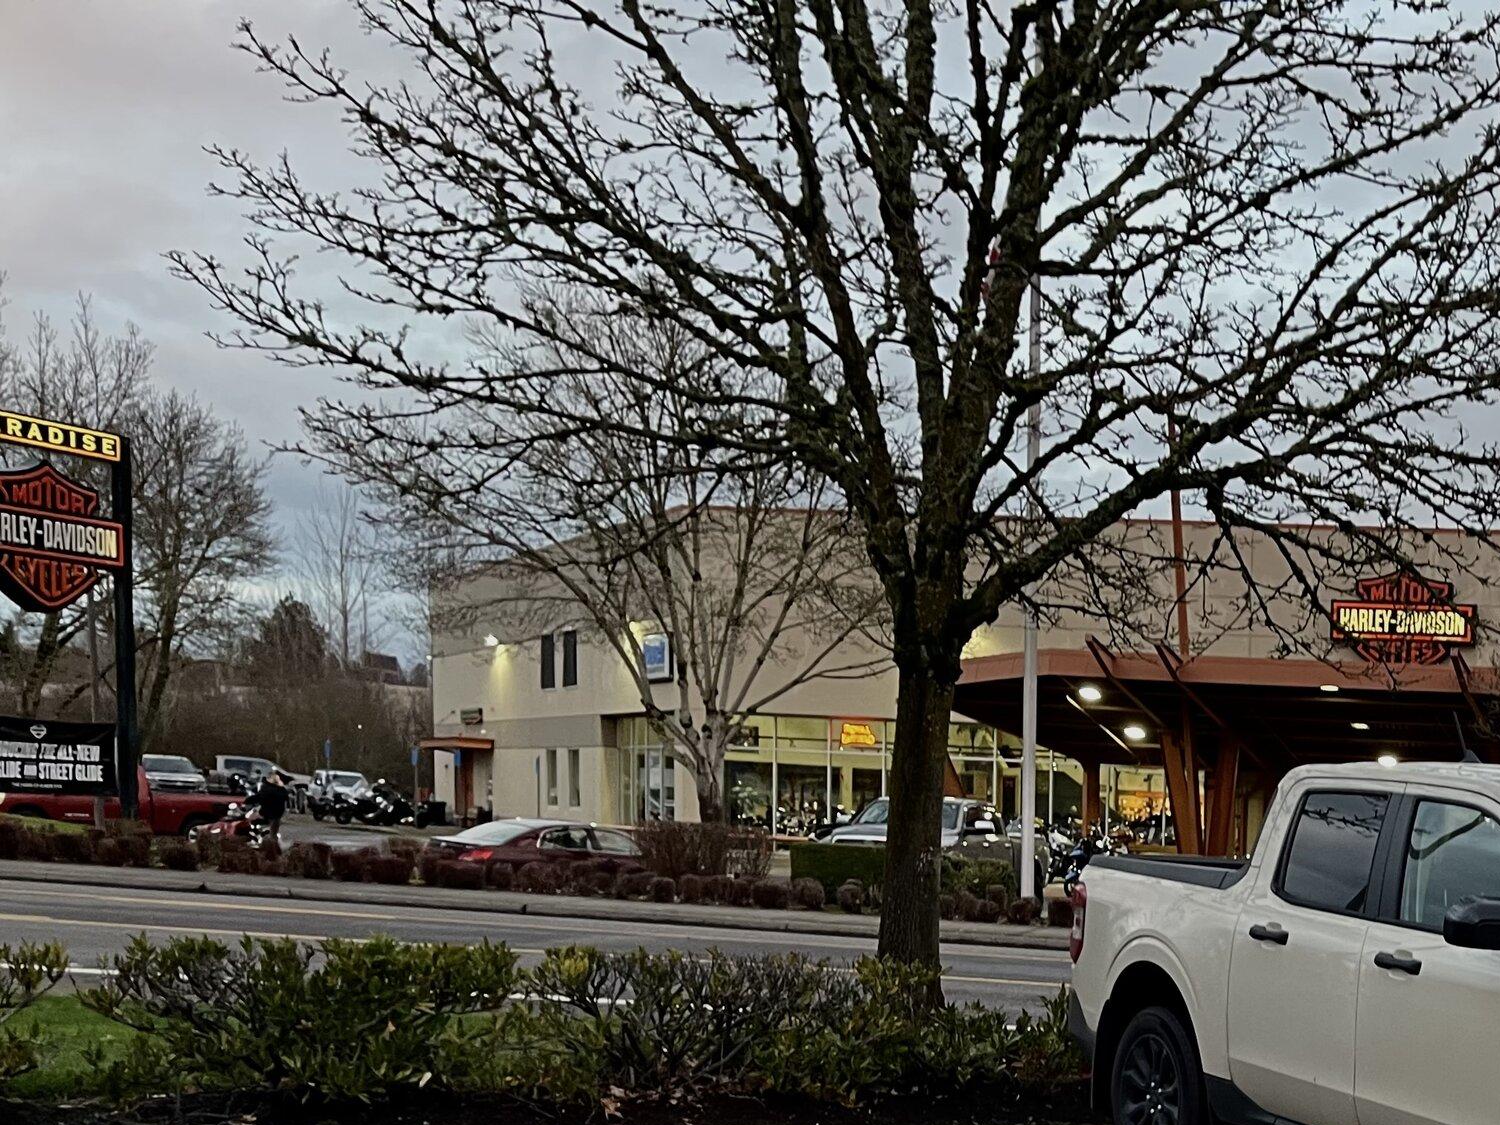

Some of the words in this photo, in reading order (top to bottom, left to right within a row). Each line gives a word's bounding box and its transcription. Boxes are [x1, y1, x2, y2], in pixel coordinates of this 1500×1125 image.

[0, 418, 116, 456] RADISE
[13, 476, 85, 515] MOTOR
[1339, 607, 1466, 636] HARLEY-DAVIDSON
[39, 762, 74, 780] STREET
[75, 764, 104, 782] GLIDE
